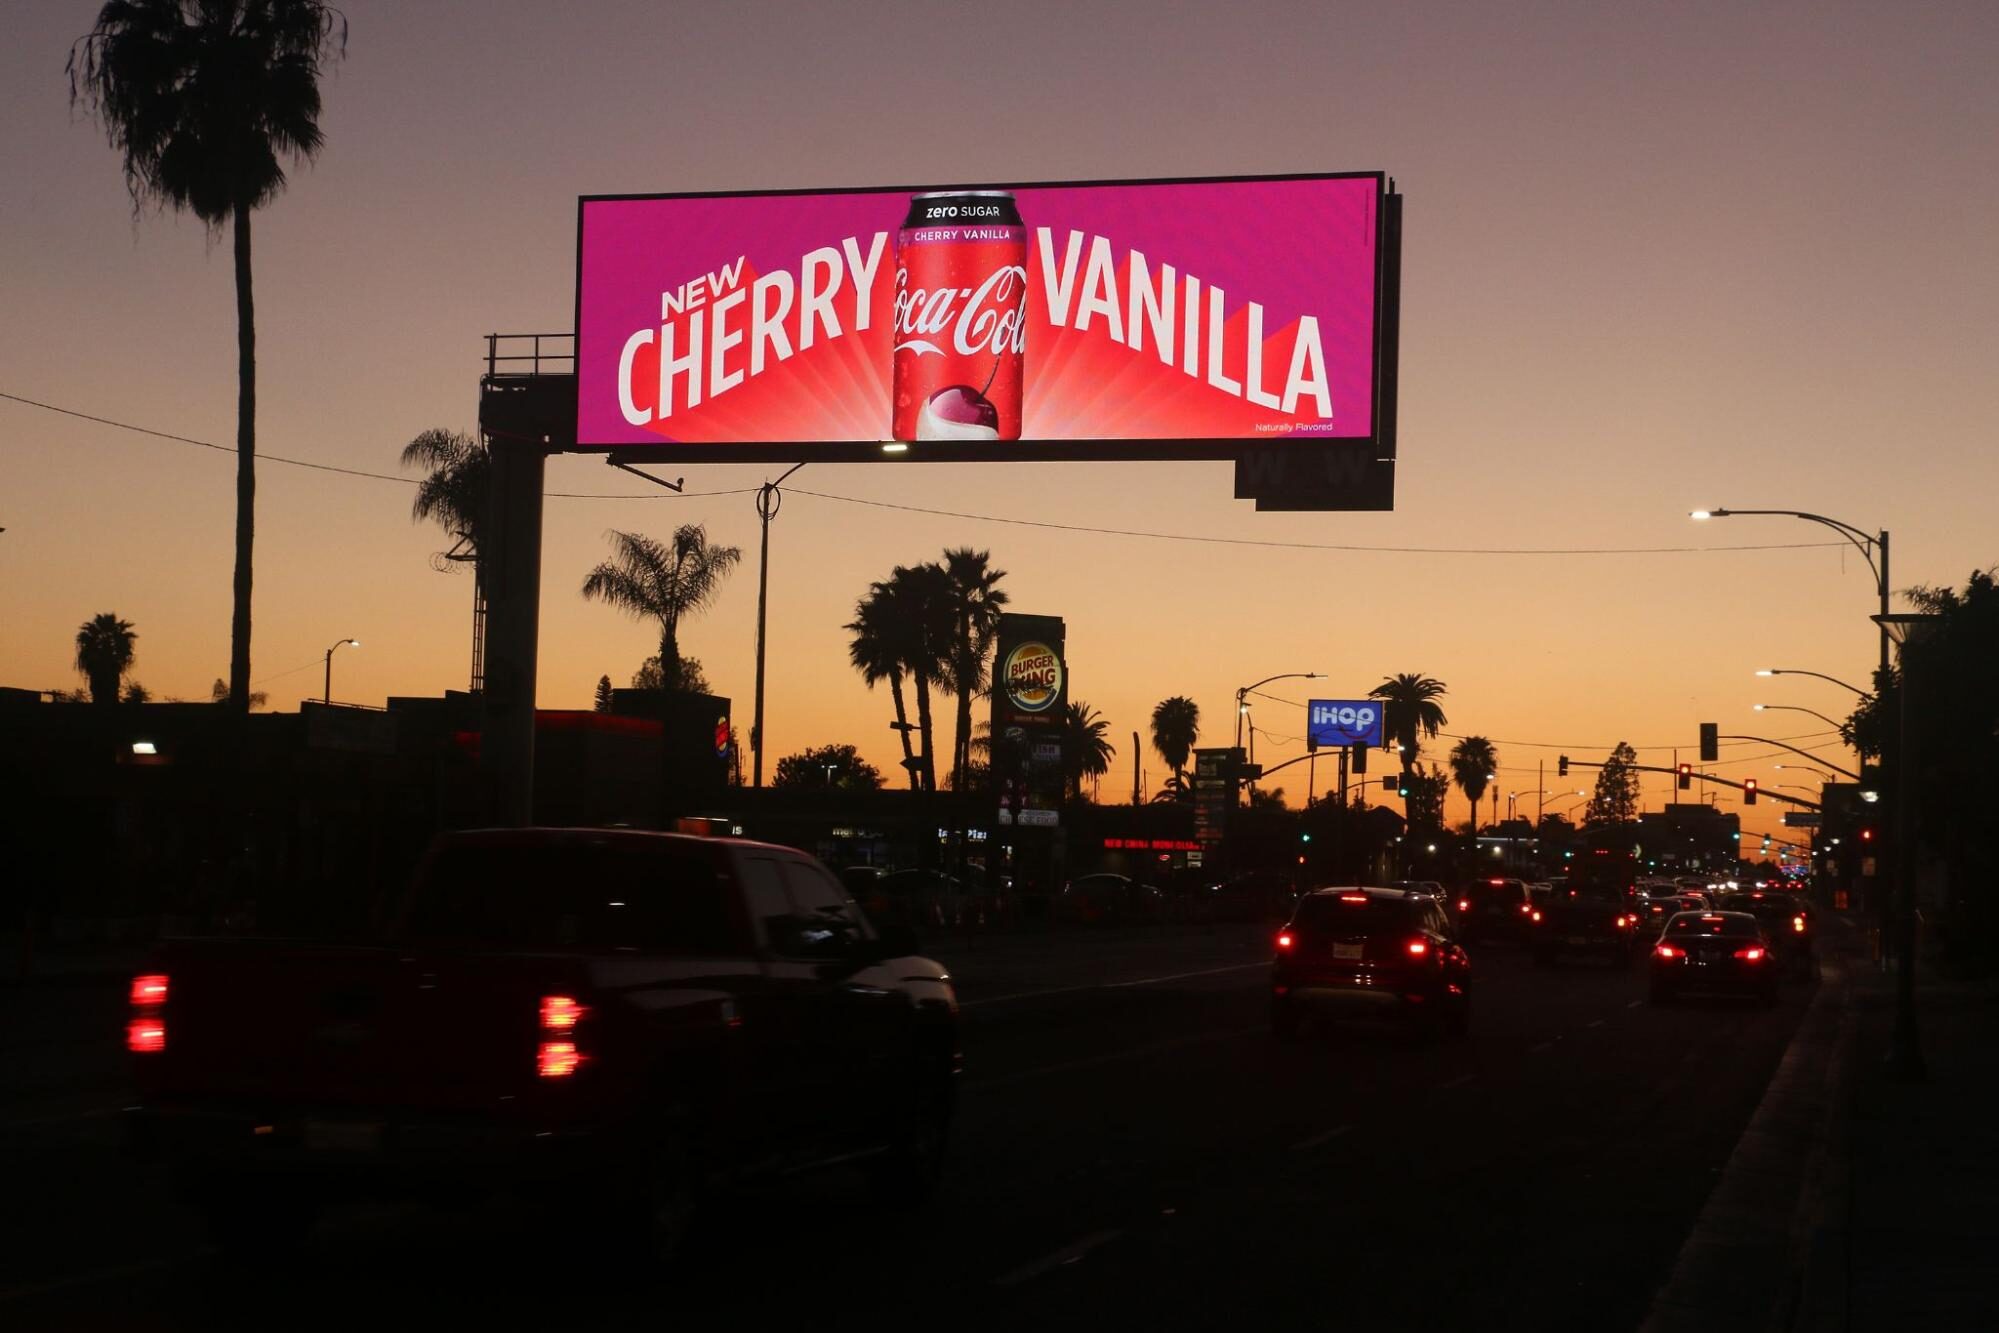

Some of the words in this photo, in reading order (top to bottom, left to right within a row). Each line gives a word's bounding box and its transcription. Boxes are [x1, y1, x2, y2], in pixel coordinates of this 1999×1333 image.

[926, 206, 958, 219] zero
[960, 206, 1000, 217] SUGAR
[914, 230, 958, 241] CHERRY
[963, 229, 1010, 240] VANILLA
[661, 255, 745, 321] NEW
[895, 265, 1027, 356] oca-Col
[617, 231, 889, 427] CHERRY
[1036, 226, 1334, 418] VANILLA
[1255, 422, 1293, 433] Naturally
[1295, 422, 1333, 432] Flavored
[1011, 655, 1054, 677] BURGER
[1013, 668, 1056, 686] ING
